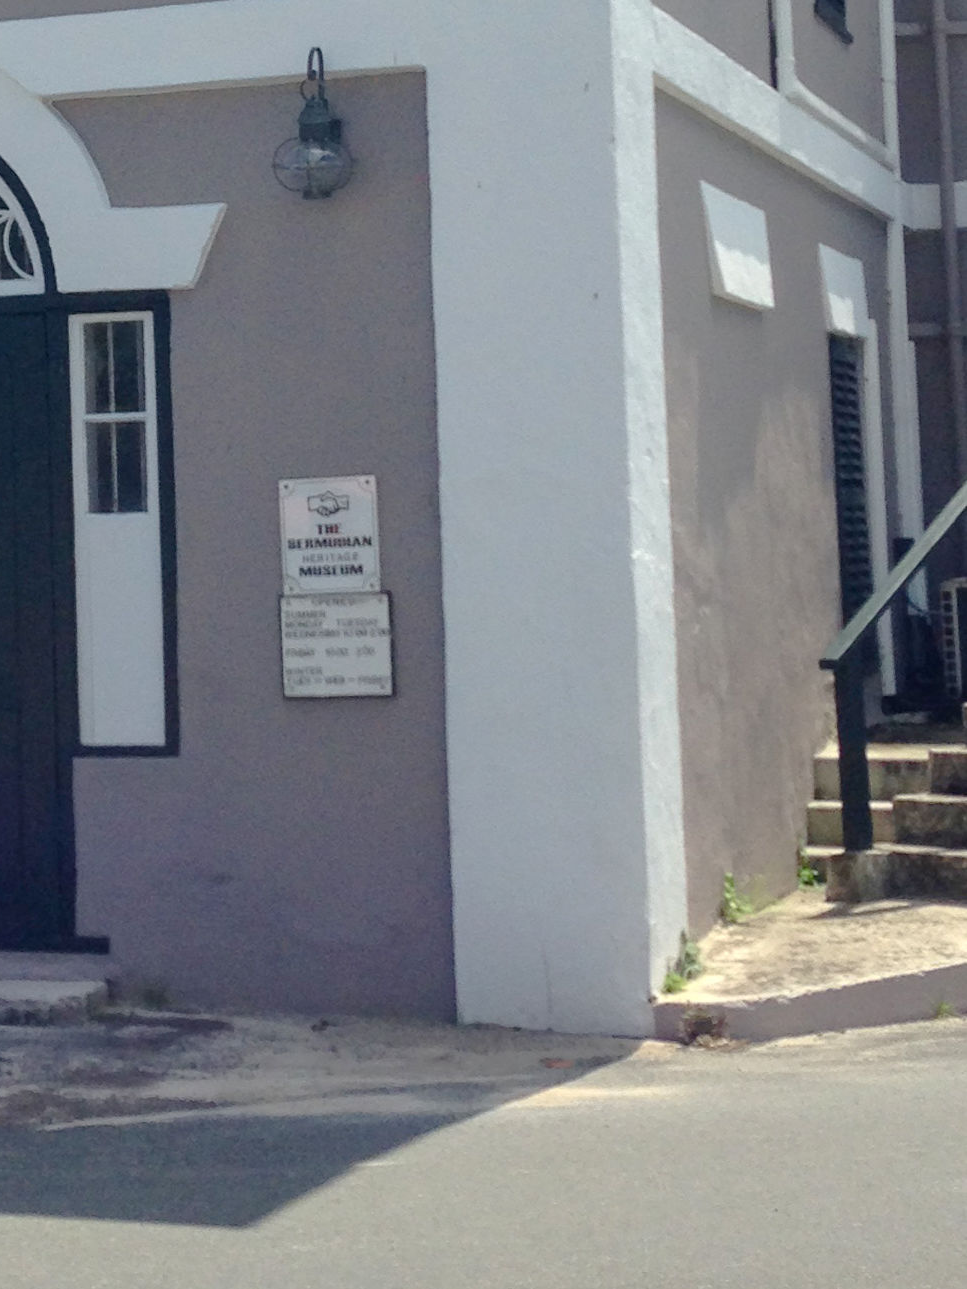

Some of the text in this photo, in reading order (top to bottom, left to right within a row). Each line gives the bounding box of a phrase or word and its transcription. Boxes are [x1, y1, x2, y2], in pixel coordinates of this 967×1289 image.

[317, 523, 340, 534] THE
[287, 536, 372, 549] BERMUDIAN
[299, 564, 363, 576] MUSEUM
